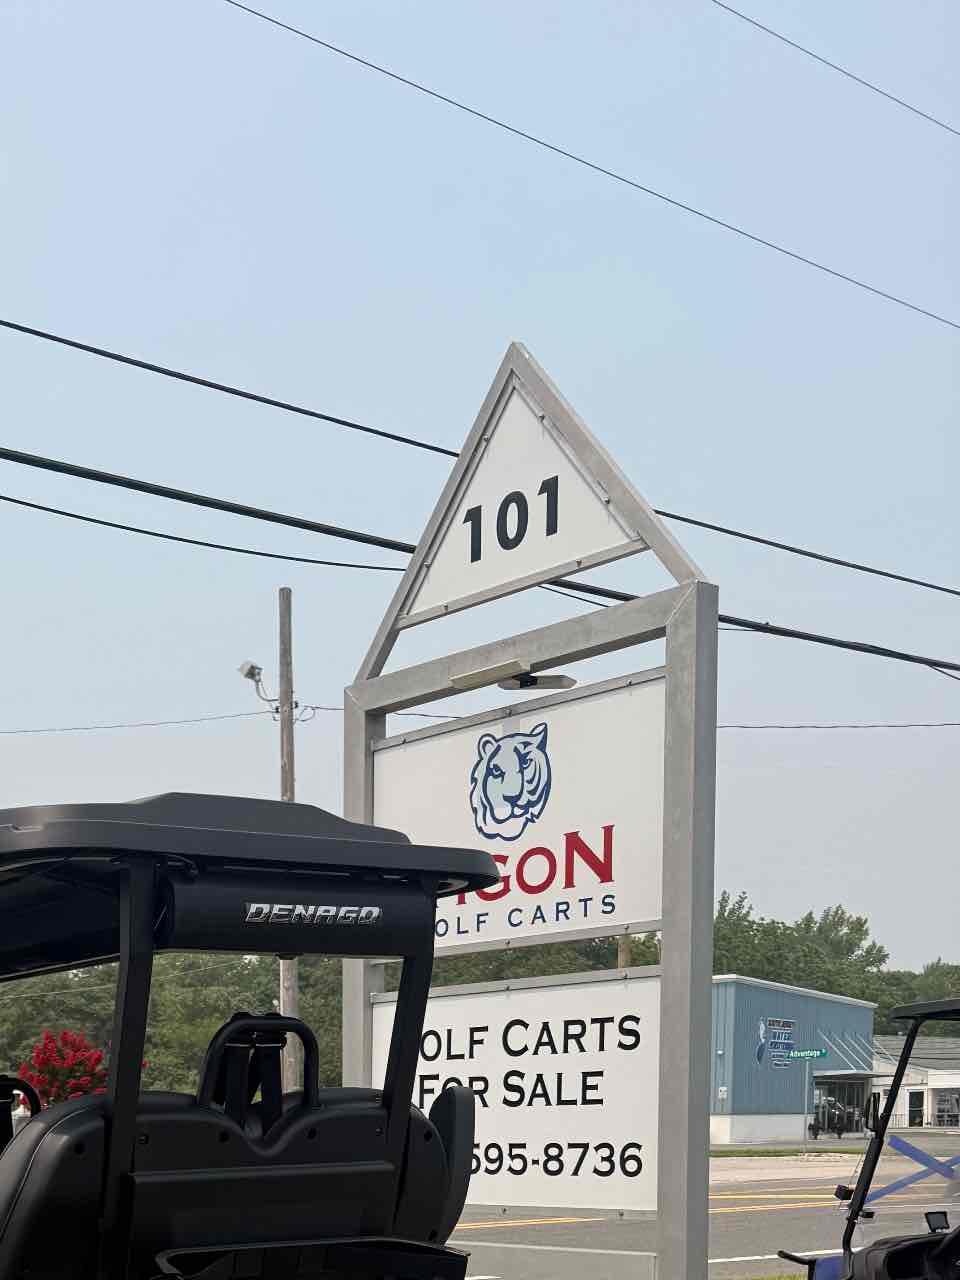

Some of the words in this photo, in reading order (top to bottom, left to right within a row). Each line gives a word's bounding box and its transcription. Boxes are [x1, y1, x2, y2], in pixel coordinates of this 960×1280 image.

[462, 475, 559, 563] 101
[436, 825, 615, 908] GON
[245, 903, 382, 925] DENAGO
[435, 912, 489, 938] OLF
[508, 894, 616, 928] CARTS
[420, 1026, 489, 1061] OLF
[502, 1015, 641, 1057] CARTS
[789, 1049, 821, 1058] Advantage
[502, 1070, 604, 1107] SALE
